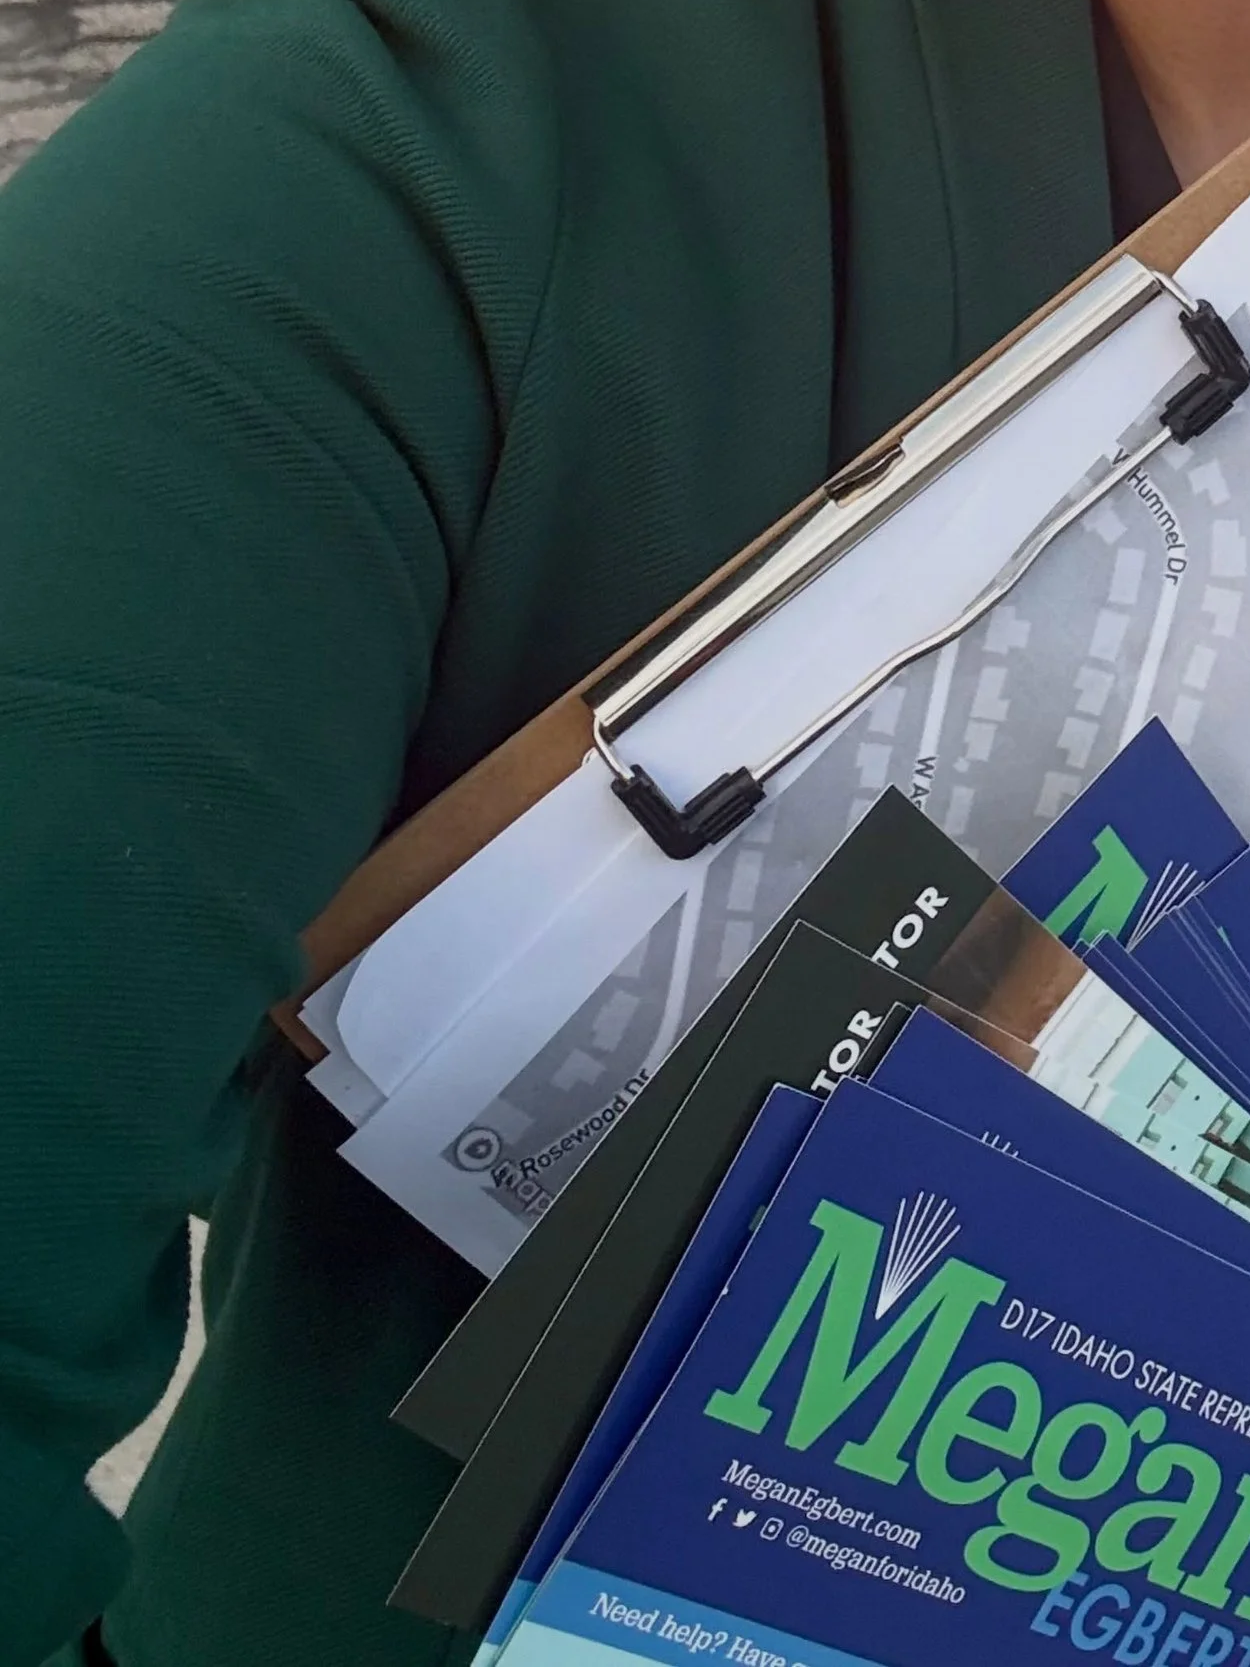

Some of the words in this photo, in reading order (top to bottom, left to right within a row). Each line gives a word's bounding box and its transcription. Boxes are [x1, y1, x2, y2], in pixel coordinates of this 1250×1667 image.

[1127, 467, 1186, 552] Hummel
[1164, 556, 1187, 585] Dr
[914, 756, 937, 780] W
[870, 886, 950, 970] TOR
[810, 1009, 883, 1094] TOR
[519, 1093, 628, 1179] Rosewood
[1052, 1320, 1135, 1380] IDAHO
[1135, 1360, 1203, 1411] STATE
[721, 1459, 922, 1550] MeganEgbert.com
[786, 1525, 966, 1604] @meganforidaho
[588, 1591, 661, 1634] Need
[657, 1613, 729, 1654] help?
[725, 1635, 787, 1667] Have
